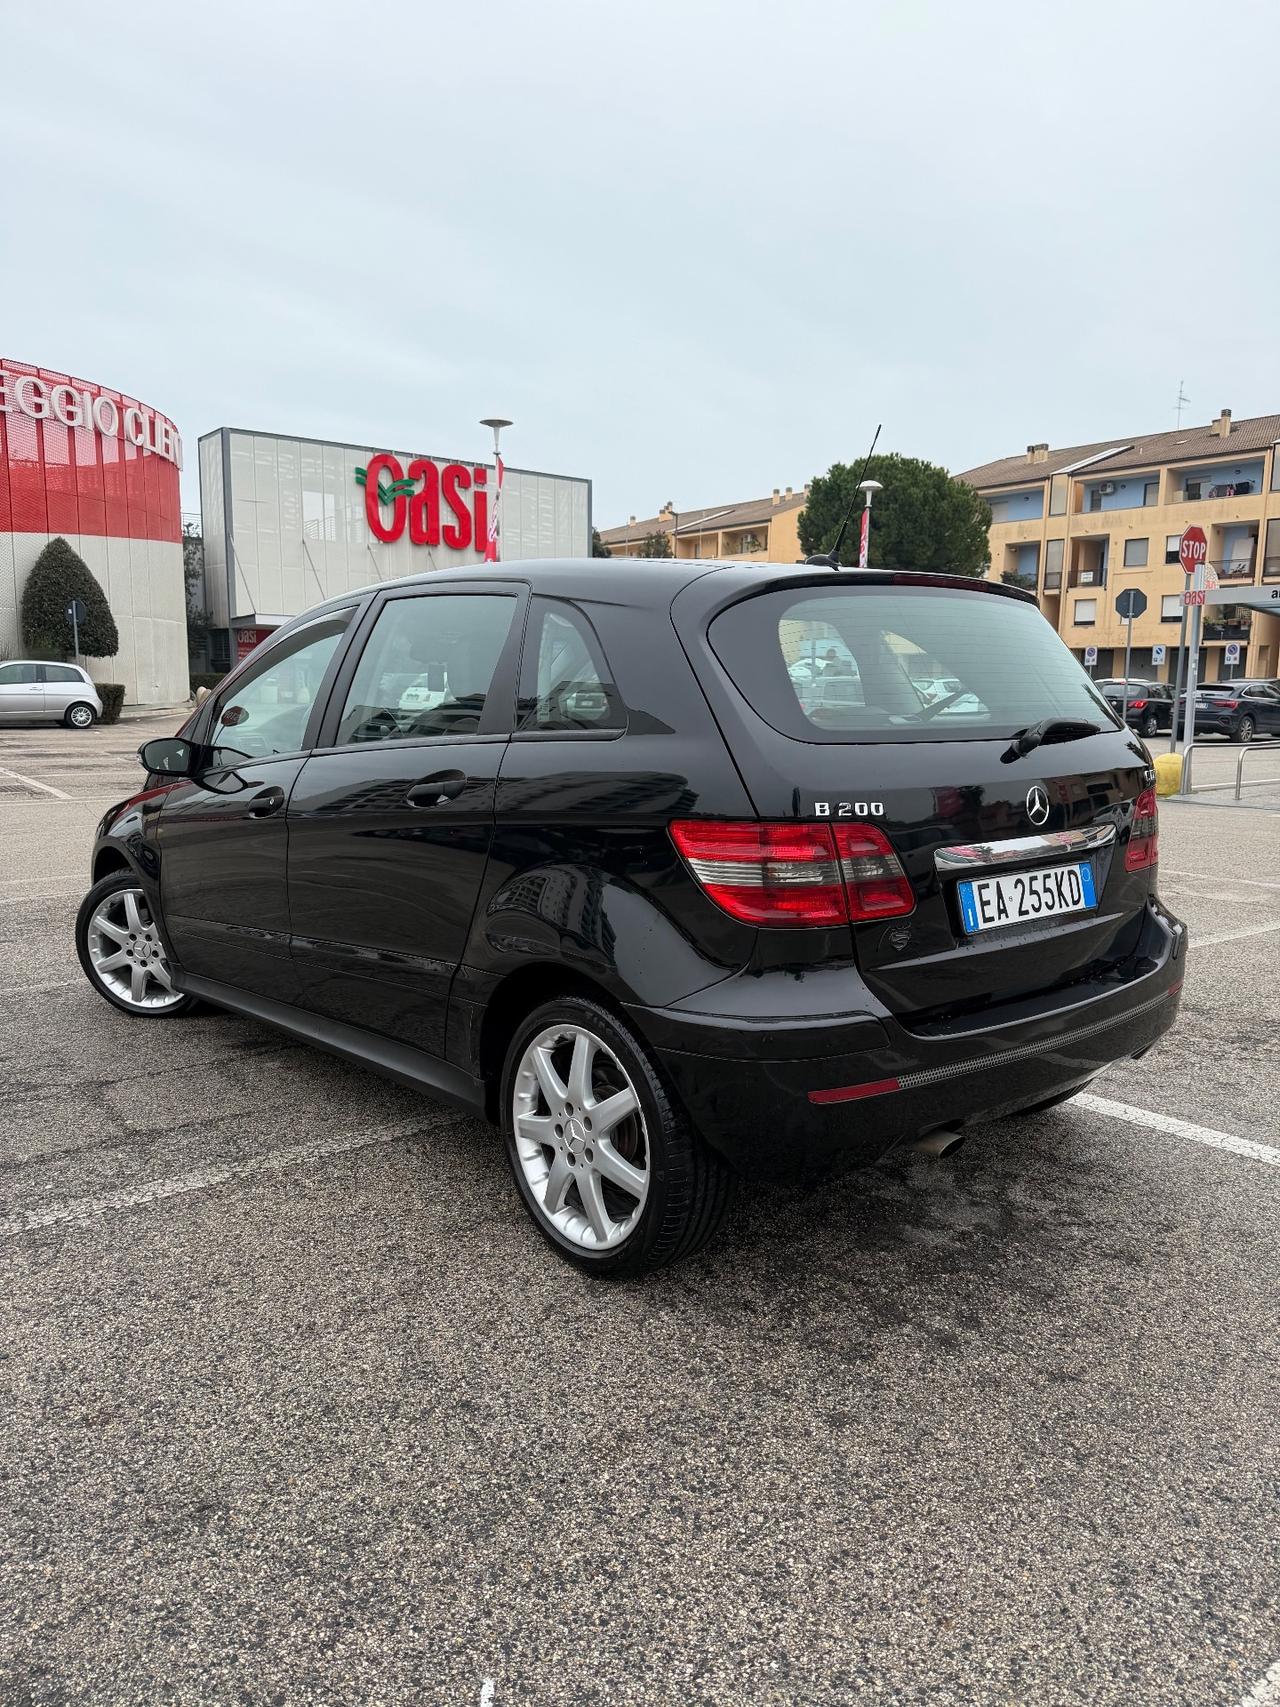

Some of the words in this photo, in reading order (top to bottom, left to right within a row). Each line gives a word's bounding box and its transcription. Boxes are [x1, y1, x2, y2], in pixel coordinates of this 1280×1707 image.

[1182, 540, 1206, 559] STOP
[815, 802, 830, 817] B
[839, 802, 884, 816] 200
[977, 881, 1009, 923] EA
[1014, 869, 1081, 916] 255KD
